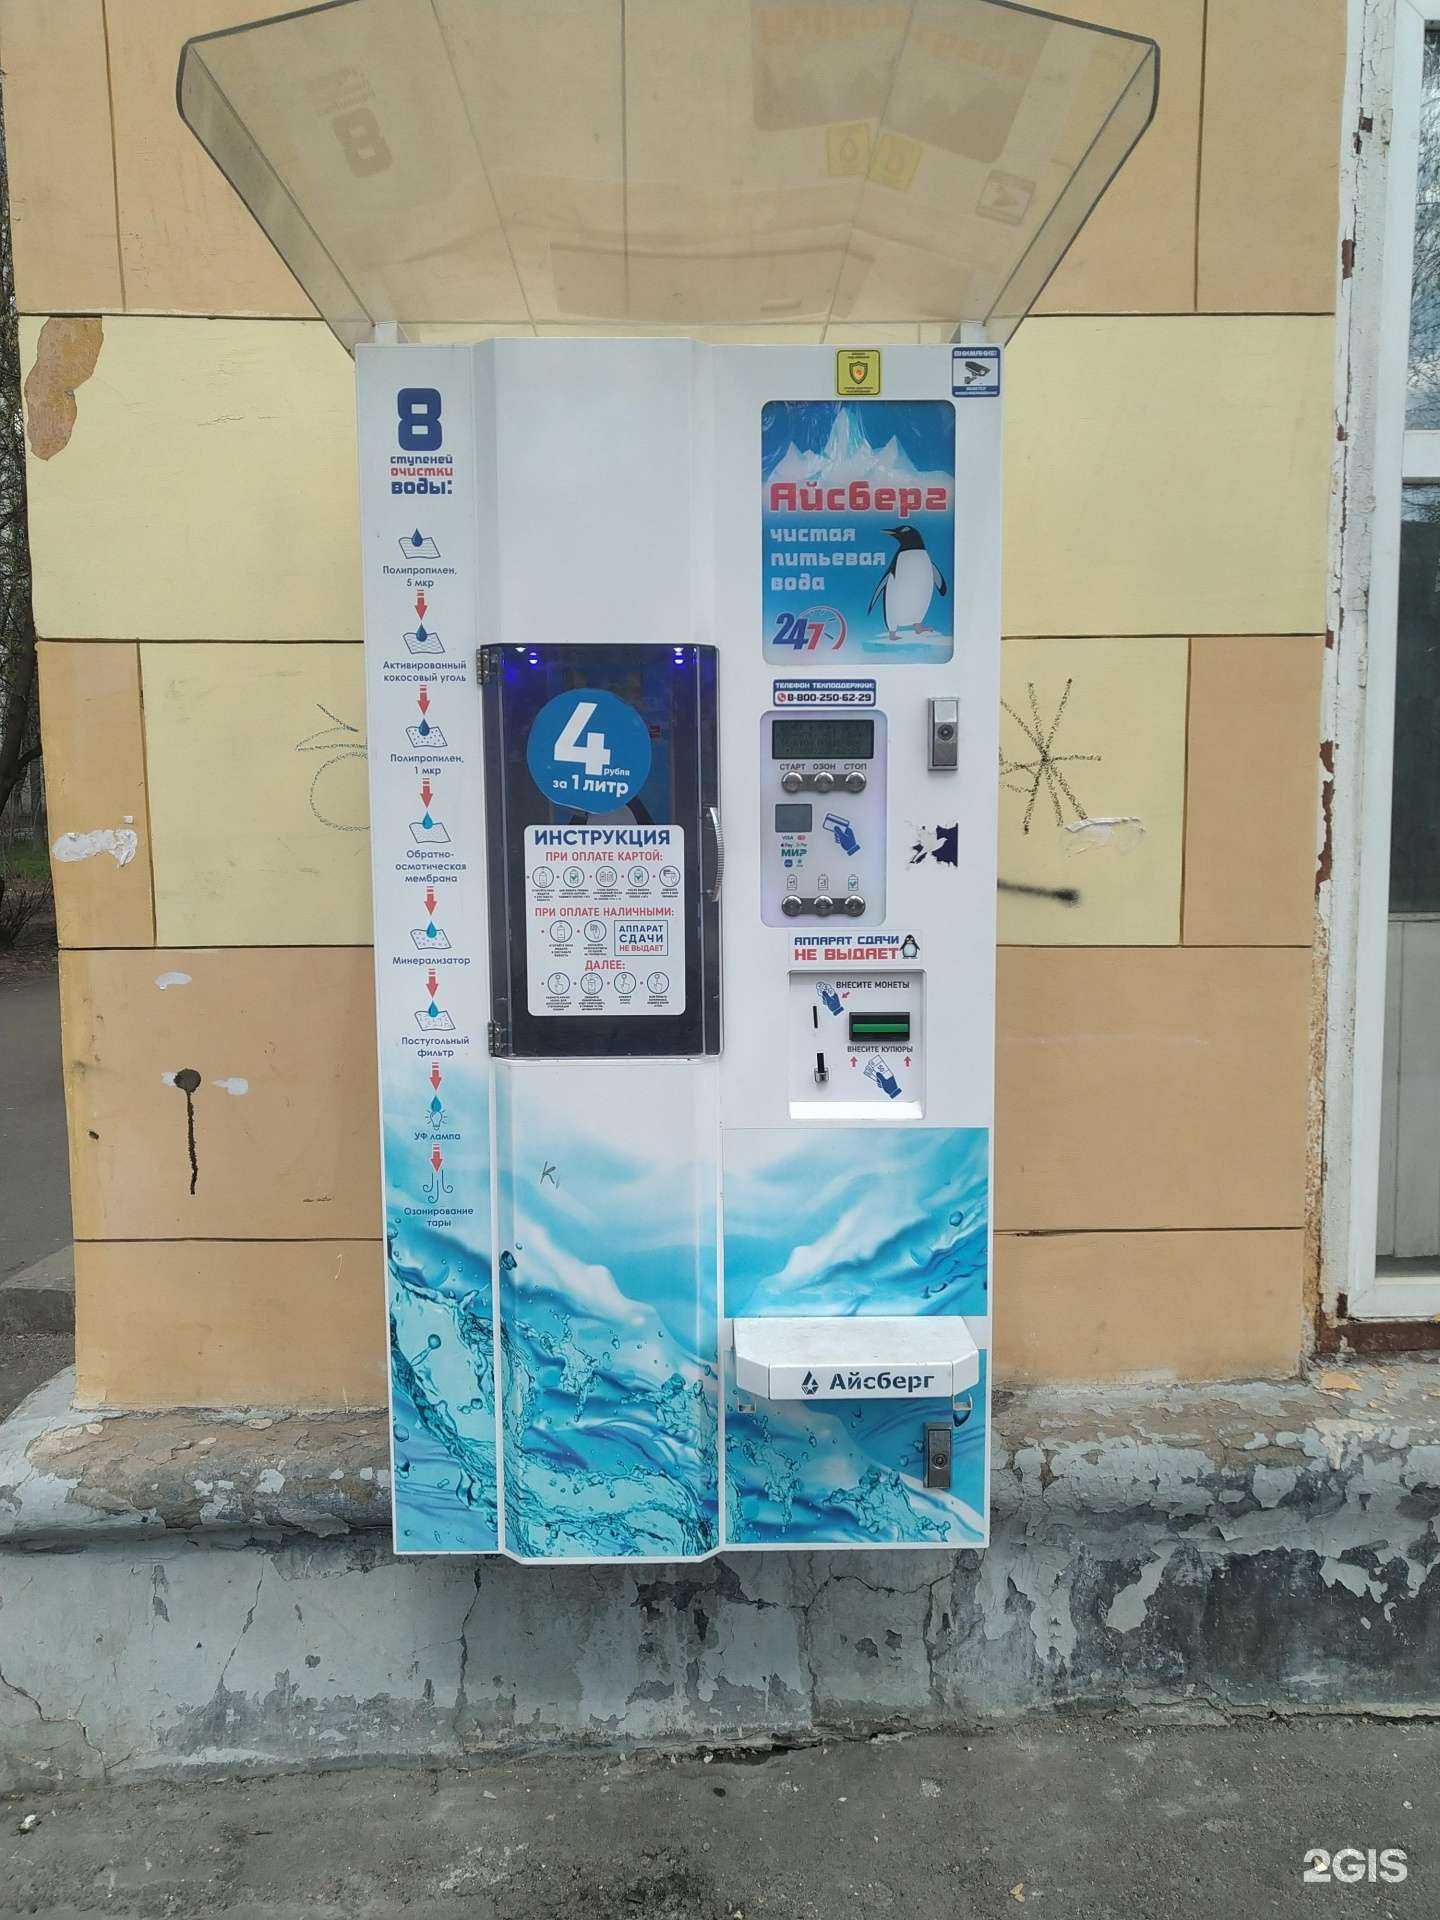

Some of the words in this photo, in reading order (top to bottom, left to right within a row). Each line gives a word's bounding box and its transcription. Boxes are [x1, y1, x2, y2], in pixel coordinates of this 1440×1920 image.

[397, 387, 443, 451] 8
[390, 455, 453, 466] ступеней
[390, 466, 453, 478] очистки
[391, 478, 453, 495] воды:
[769, 481, 948, 518] Айсберг
[771, 527, 856, 542] чистая
[771, 551, 886, 567] питьевая
[382, 565, 457, 577] Полипропилен,
[406, 578, 412, 587] 5
[414, 579, 434, 589] мкр
[771, 573, 825, 591] вода
[383, 660, 467, 670] Активированный
[383, 672, 438, 683] кокосовый
[440, 673, 467, 684] уголь
[787, 693, 872, 702] 8-800-250-62-29
[553, 701, 611, 775] 4
[603, 766, 630, 778] рубля
[390, 753, 464, 764] Полипропилен,
[414, 766, 419, 775] 1
[422, 768, 442, 777] мкр
[553, 779, 567, 790] за
[572, 775, 579, 790] 1
[583, 779, 629, 798] литр
[534, 829, 671, 847] ИНСТРУКЦИЯ
[406, 850, 454, 860] Обратно-
[545, 852, 568, 861] ПРИ
[572, 852, 614, 861] ОПЛАТЕ
[618, 849, 664, 861] КАРТОЙ:
[781, 849, 808, 857] МИР
[395, 863, 467, 871] осмотическая
[404, 874, 458, 884] мембрана
[535, 908, 556, 917] ПРИ
[559, 908, 600, 917] ОПЛАТЕ
[603, 907, 675, 917] НАЛИЧНЫМИ:
[619, 924, 664, 933] АППАРАТ
[619, 934, 664, 944] СДАЧИ
[794, 936, 853, 946] АППАРАТ
[857, 935, 900, 946] СДАЧИ
[619, 944, 630, 952] НЕ
[631, 944, 664, 952] ВЫДАЕТ
[794, 948, 818, 961] НЕ
[824, 948, 899, 961] ВЫДАЕТ
[392, 956, 471, 966] Минерализатор
[585, 960, 626, 971] ДАЛЕЕ:
[836, 981, 872, 989] ВНЕСИТЕ
[874, 981, 910, 989] МОНЕТЫ
[401, 1036, 469, 1047] Постугольный
[417, 1048, 454, 1059] фильтр
[847, 1045, 880, 1053] ВНЕСИТЕ
[881, 1045, 914, 1053] КУПЮРЫ
[414, 1132, 428, 1141] УФ
[430, 1133, 461, 1142] лампа
[404, 1206, 474, 1217] Озонирование
[426, 1219, 451, 1228] тары
[829, 1371, 935, 1393] Айсберг
